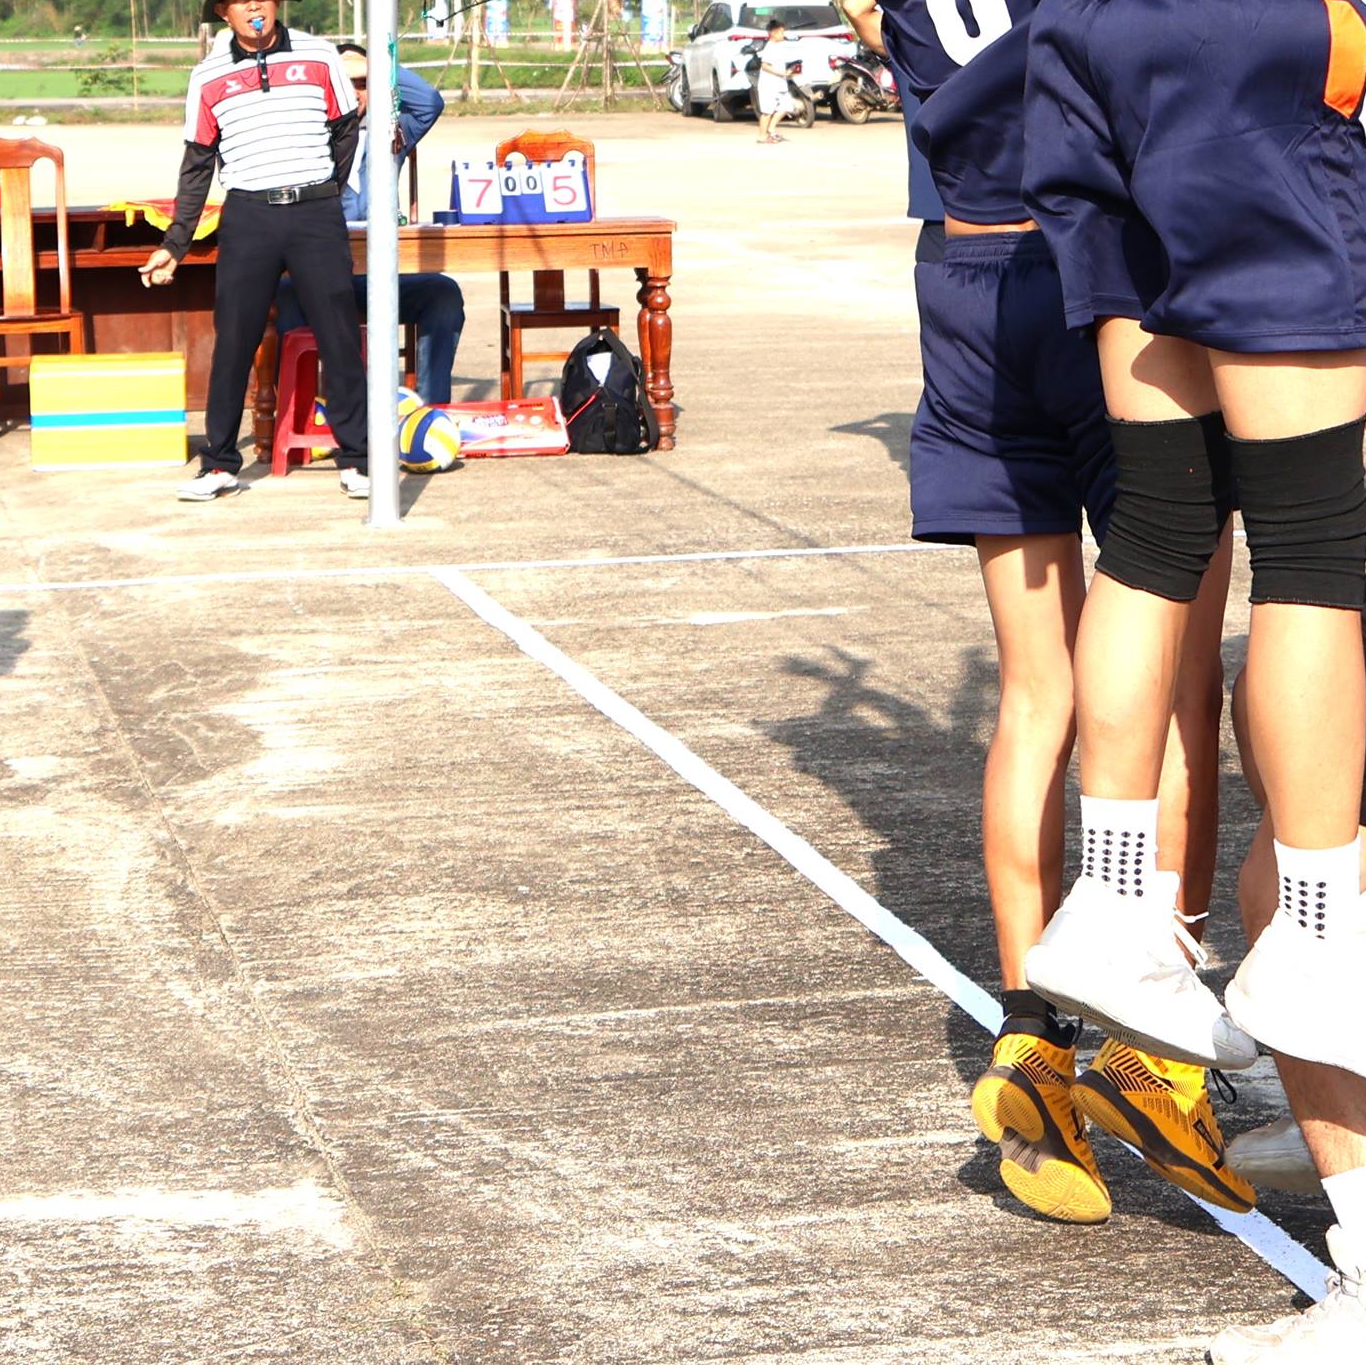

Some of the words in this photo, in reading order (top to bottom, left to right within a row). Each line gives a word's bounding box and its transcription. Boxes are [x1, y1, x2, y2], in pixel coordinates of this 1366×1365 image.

[467, 178, 493, 209] 7
[504, 175, 517, 193] 0
[525, 175, 538, 191] 0
[552, 175, 577, 206] 5
